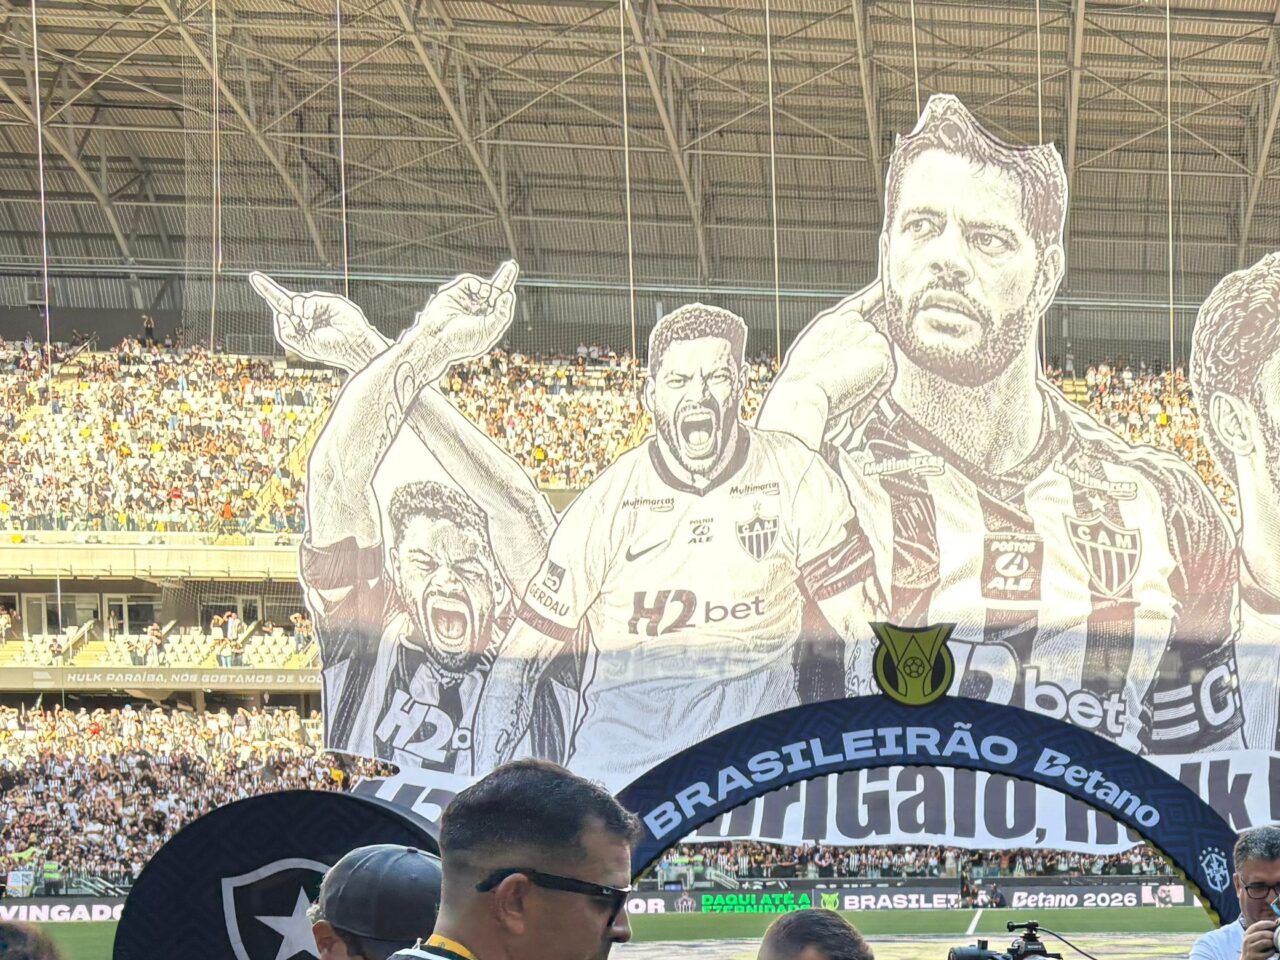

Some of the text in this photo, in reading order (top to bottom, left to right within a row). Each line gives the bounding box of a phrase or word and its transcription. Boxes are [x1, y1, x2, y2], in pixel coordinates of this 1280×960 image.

[1076, 526, 1132, 549] CAM
[529, 583, 570, 616] GERDAU
[705, 596, 765, 623] bet
[67, 673, 102, 682] HULK
[1024, 666, 1128, 733] bet
[643, 721, 1160, 840] BRASILEIRÃO Betano
[1012, 891, 1078, 907] Betano
[1083, 893, 1137, 906] 2026
